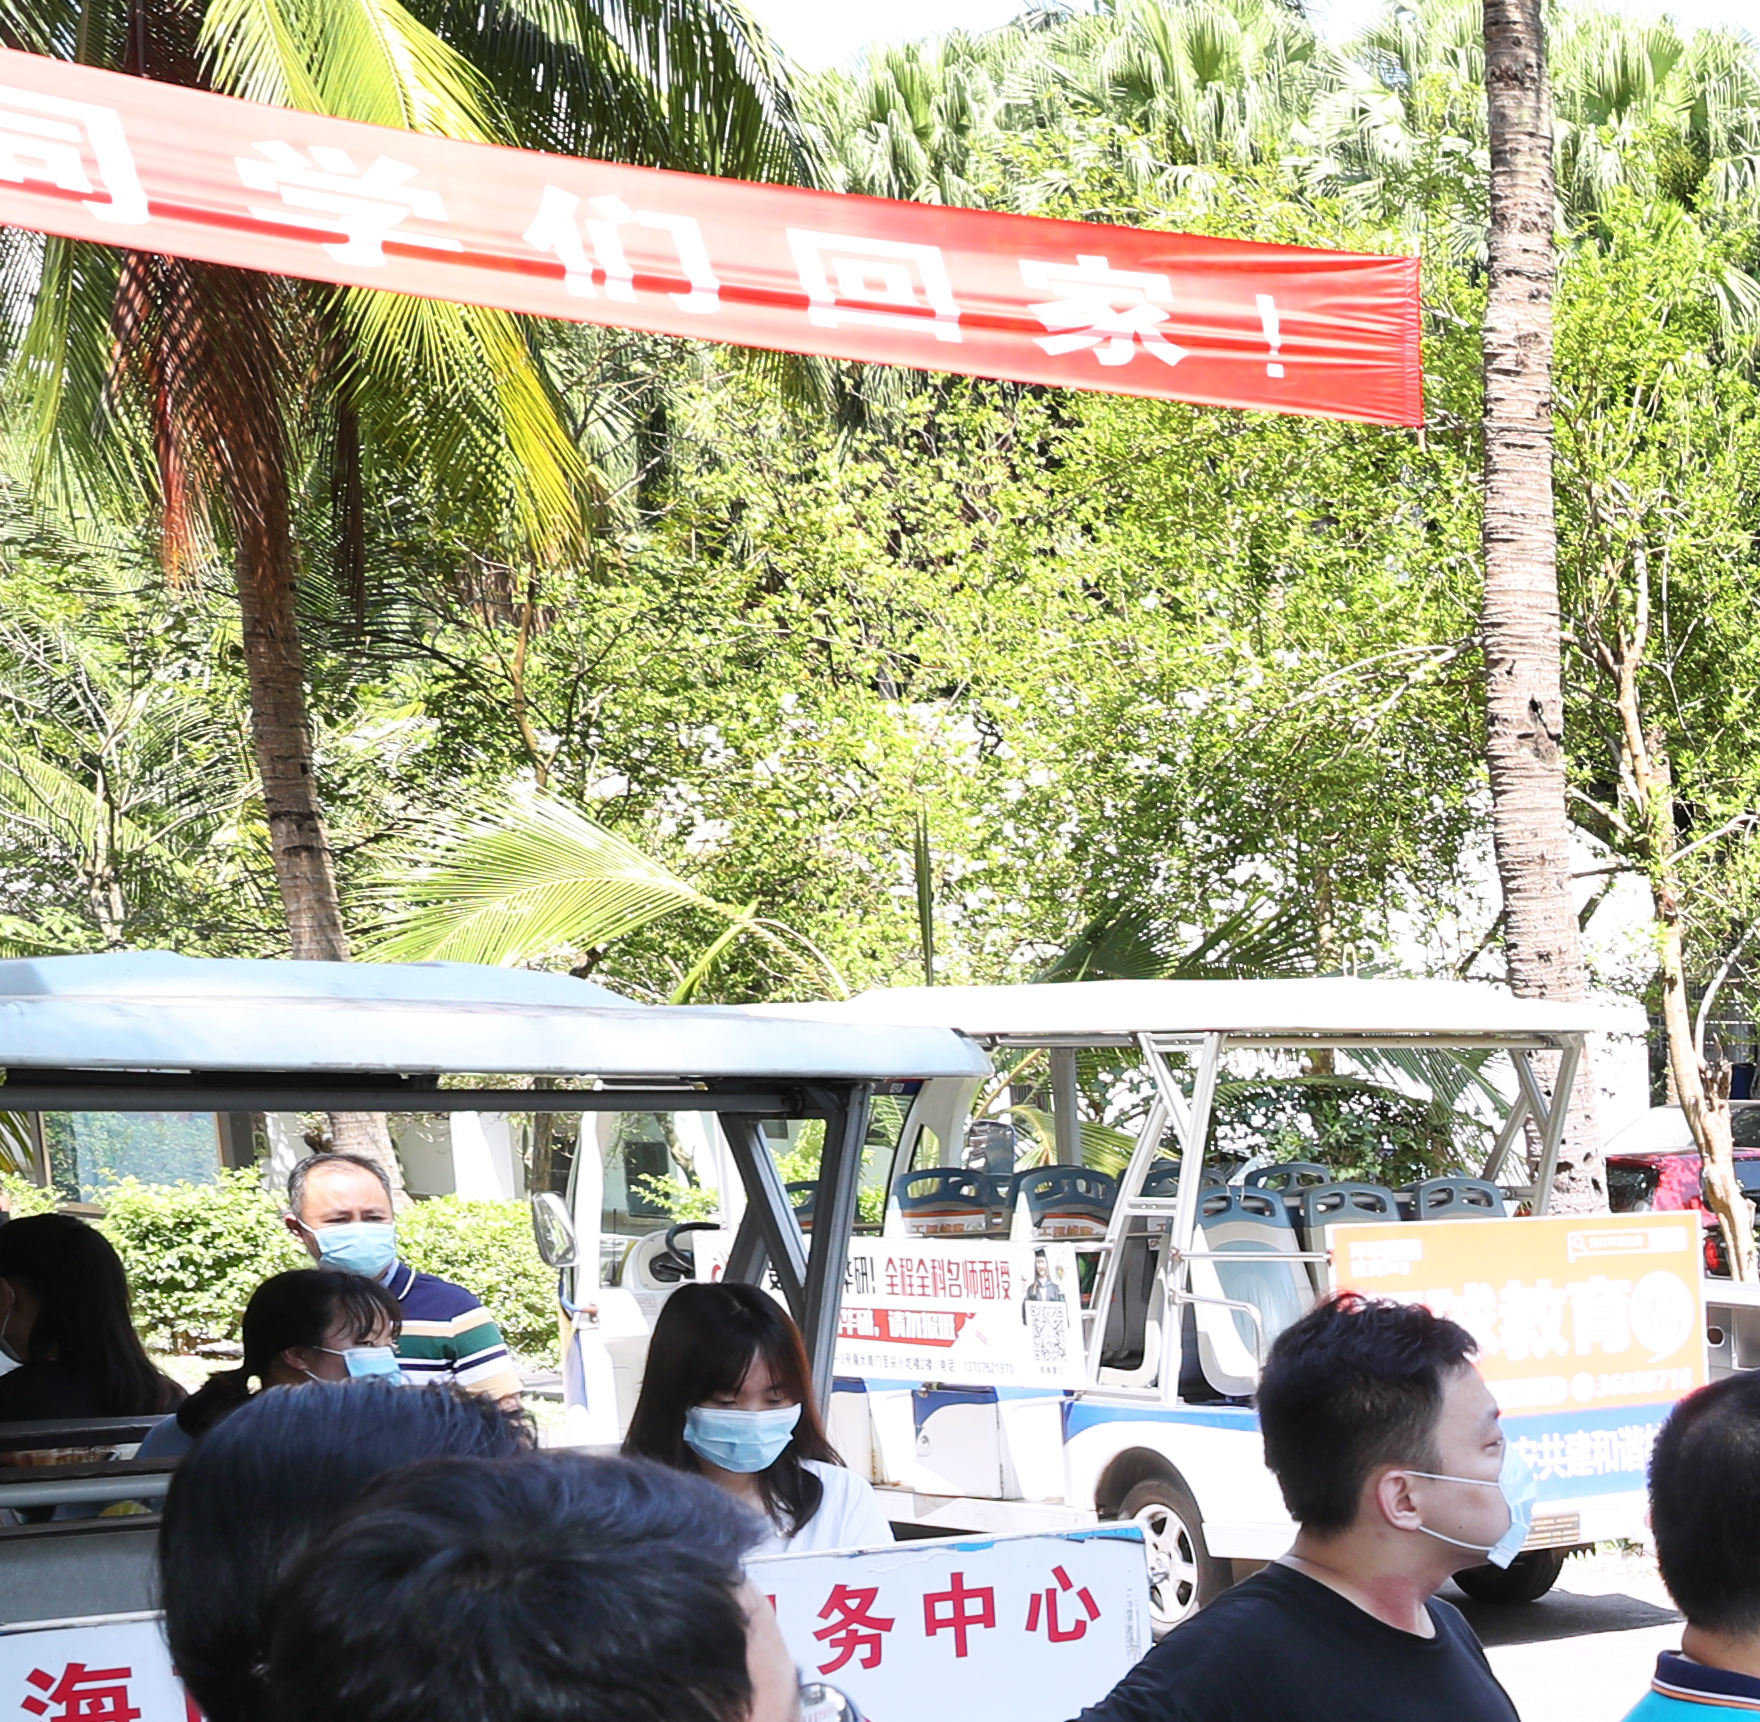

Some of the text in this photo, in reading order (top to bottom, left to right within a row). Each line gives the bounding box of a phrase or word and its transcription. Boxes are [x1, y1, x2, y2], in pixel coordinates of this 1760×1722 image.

[885, 1256, 1012, 1300] 全程全科名师面授
[767, 1564, 1102, 1676] 务中心
